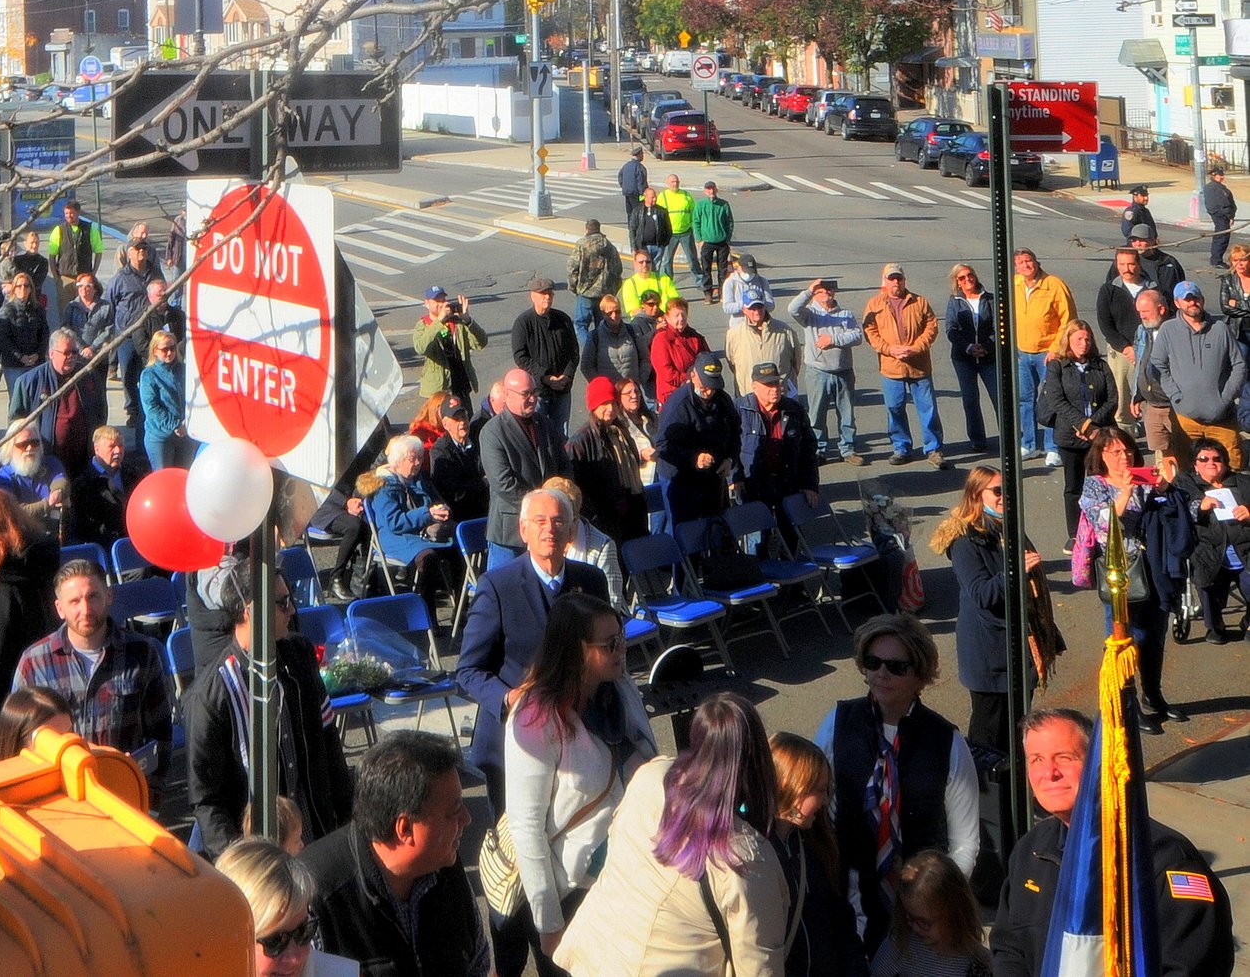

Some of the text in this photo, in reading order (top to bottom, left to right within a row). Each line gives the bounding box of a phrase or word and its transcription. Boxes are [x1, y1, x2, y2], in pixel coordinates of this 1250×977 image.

[1008, 105, 1050, 120] nytime
[1019, 88, 1080, 101] STANDING
[163, 105, 365, 144] ONE WAY
[213, 232, 303, 286] DO NOT
[218, 350, 296, 413] ENTER
